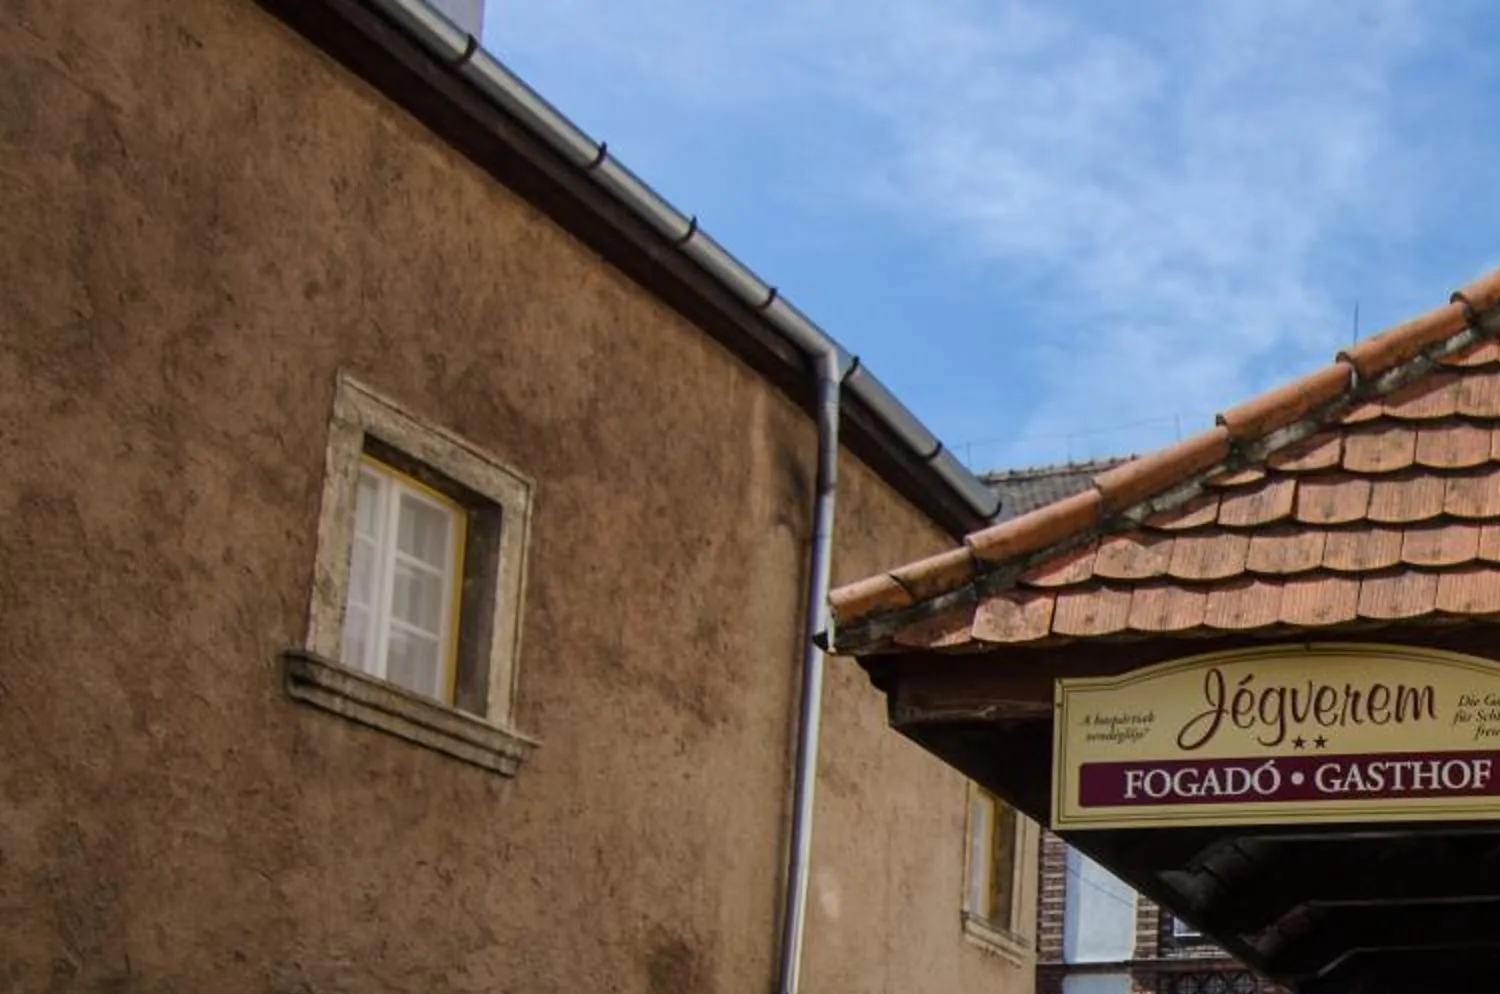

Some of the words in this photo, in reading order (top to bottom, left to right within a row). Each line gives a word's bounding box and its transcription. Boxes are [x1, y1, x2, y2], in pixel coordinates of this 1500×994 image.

[1177, 667, 1438, 751] Jégverem
[1123, 760, 1281, 799] FOGADÓ
[1314, 759, 1492, 793] GASTHOF
